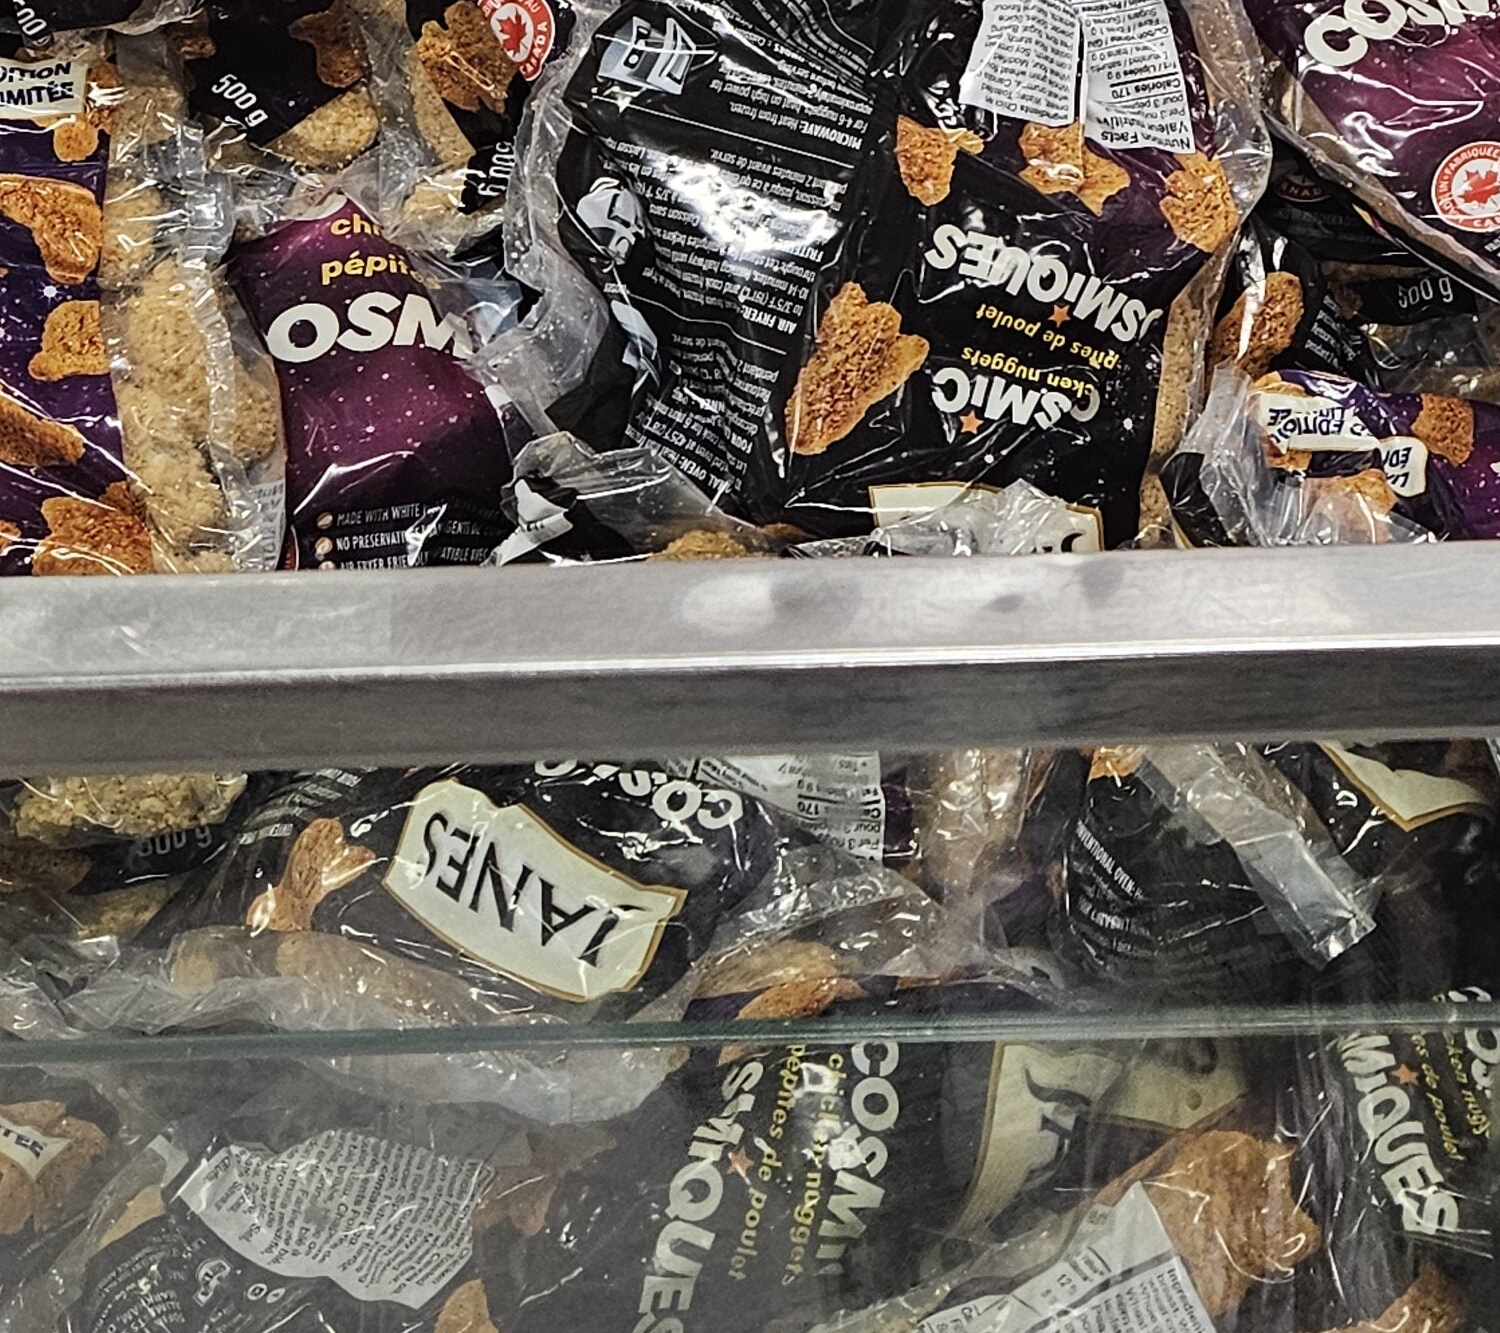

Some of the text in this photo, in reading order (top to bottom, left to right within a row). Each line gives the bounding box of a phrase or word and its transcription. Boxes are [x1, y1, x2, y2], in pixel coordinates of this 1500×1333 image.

[213, 74, 268, 129] 500 g
[1112, 77, 1181, 100] Calories 170
[758, 109, 777, 124] from
[778, 114, 798, 130] Heat
[798, 120, 862, 149] MICROWAVE:
[1101, 130, 1138, 144] Facts
[723, 282, 741, 297] and
[925, 224, 1163, 342] SMIQUES
[1440, 276, 1455, 303] g
[741, 305, 796, 335] AIR FRYER:
[976, 303, 1066, 351] de poulet
[961, 346, 1040, 385] nuggets
[337, 504, 422, 528] MADE WITH WHITE
[337, 536, 349, 552] NO
[421, 810, 650, 968] JANES
[1337, 1034, 1459, 1233] MIQUES
